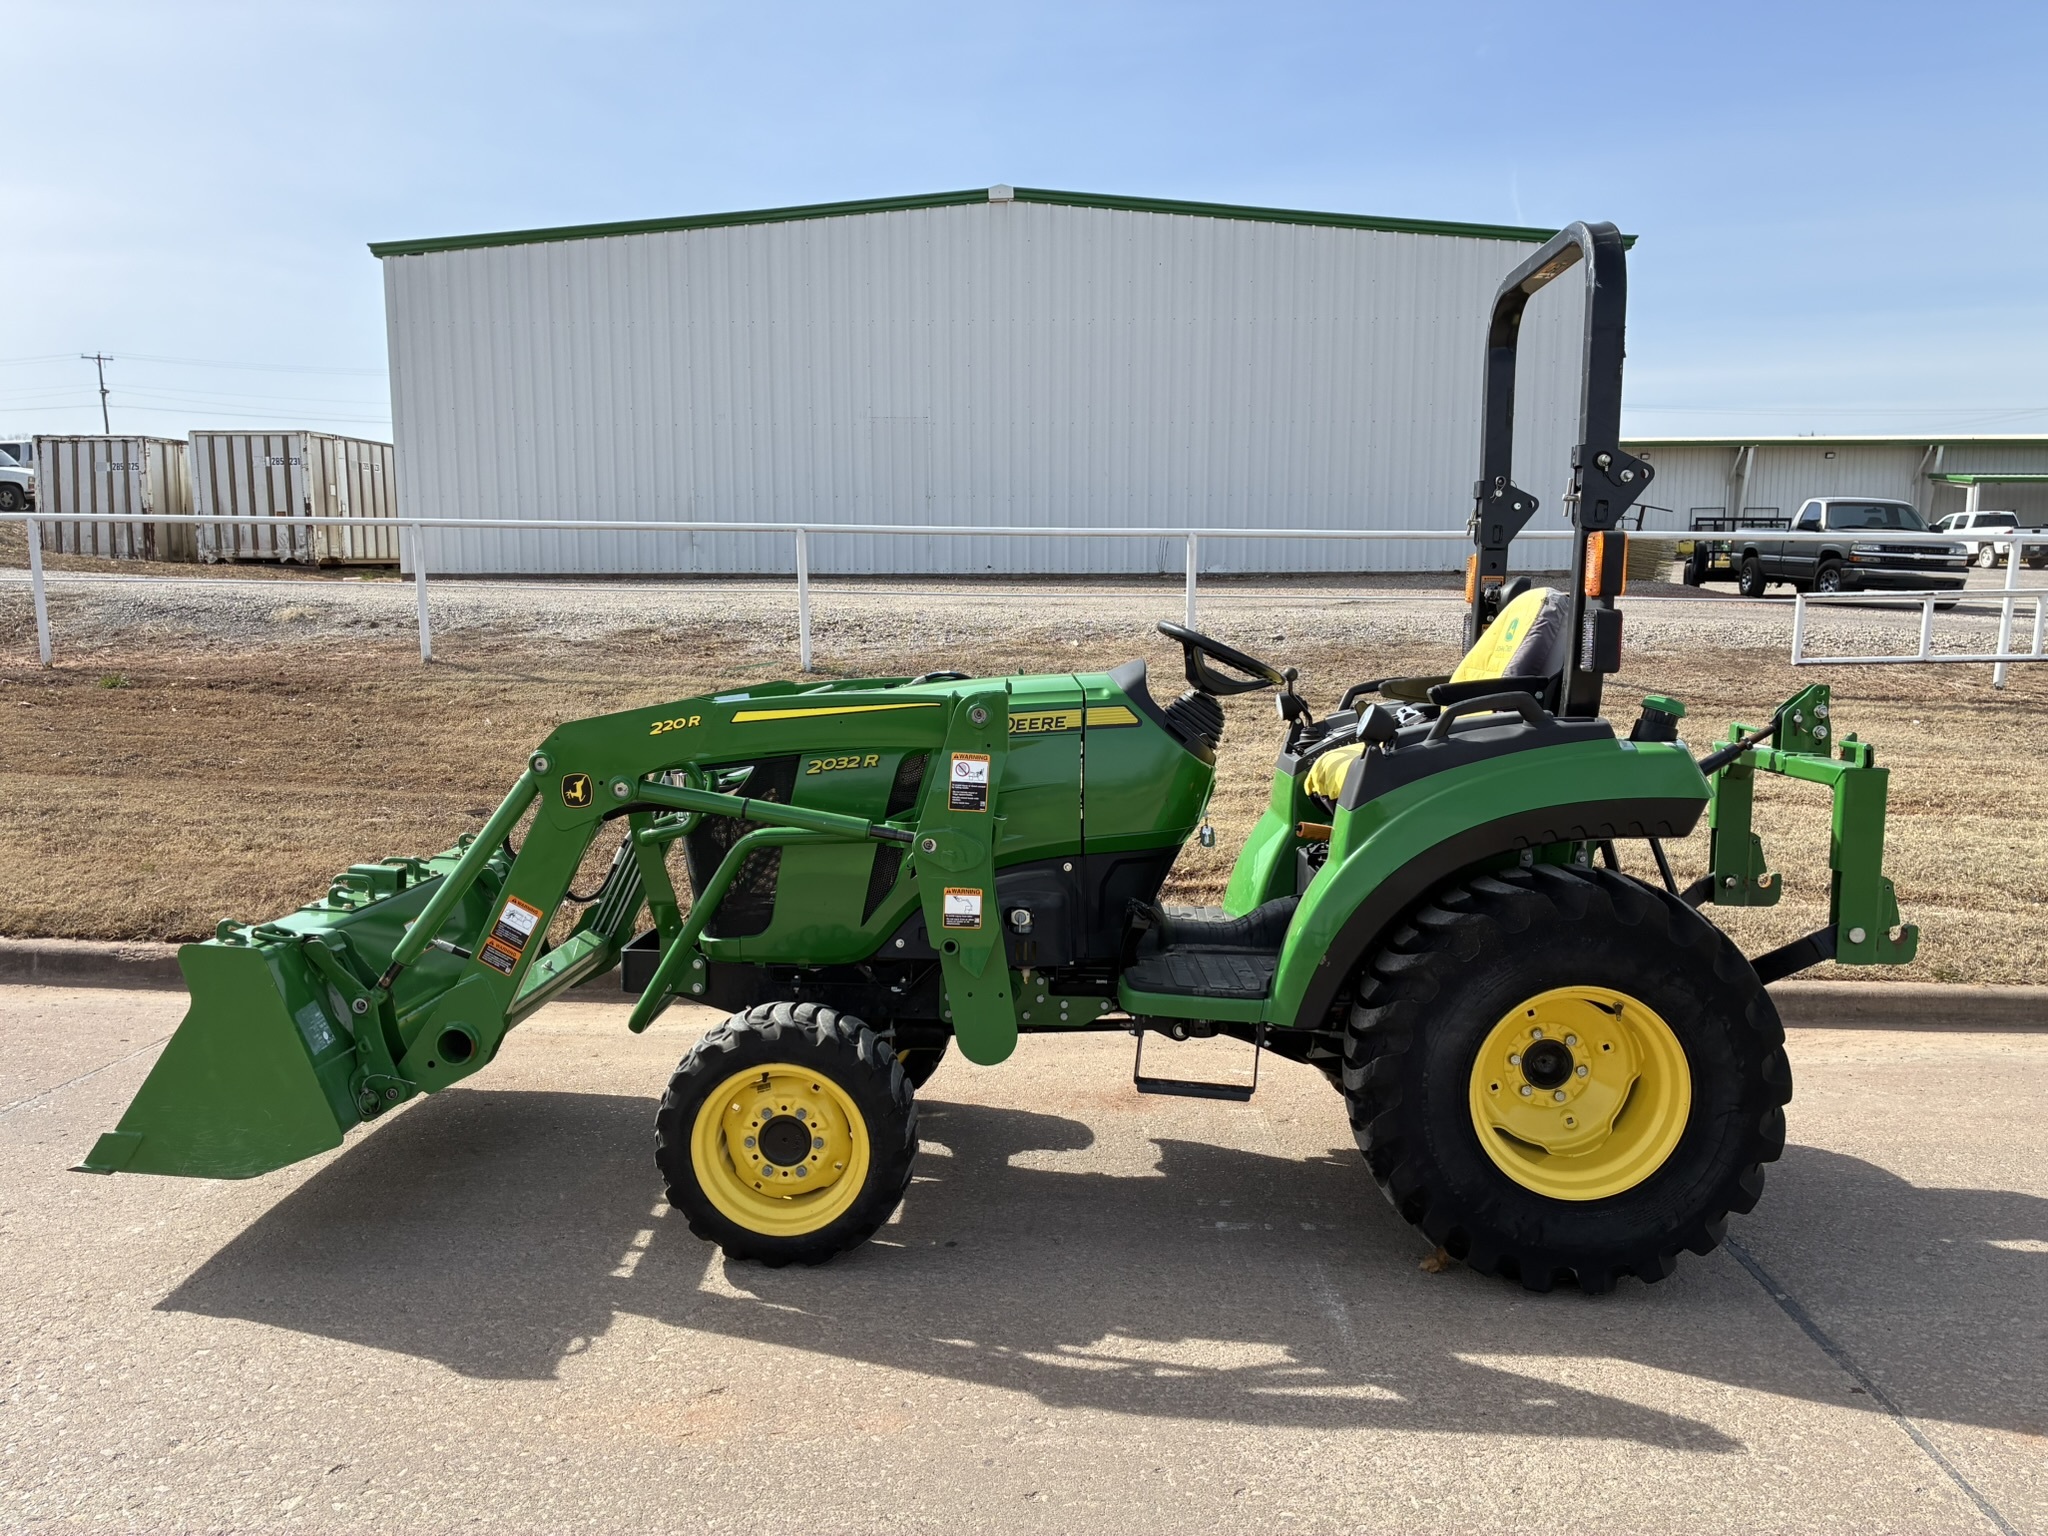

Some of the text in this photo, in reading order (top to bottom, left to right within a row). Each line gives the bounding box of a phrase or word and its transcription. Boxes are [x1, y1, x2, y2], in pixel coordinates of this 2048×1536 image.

[649, 715, 702, 736] 220 R
[806, 753, 880, 775] 2032 R
[959, 753, 988, 761] WARNING
[517, 901, 539, 915] WARNING
[495, 942, 517, 957] WARNING
